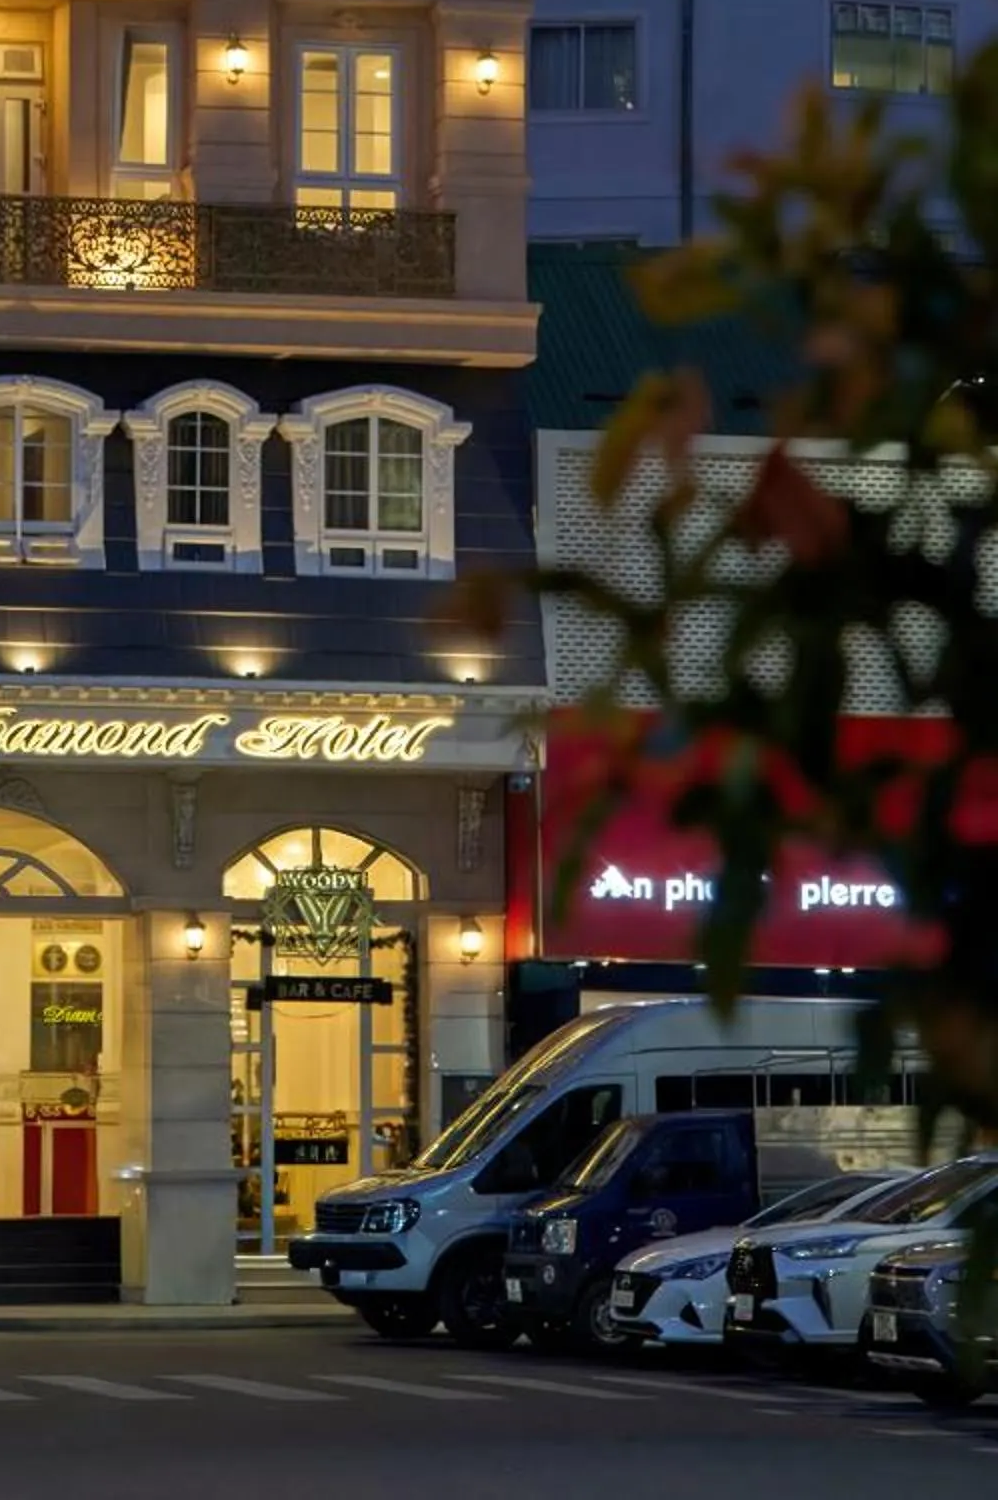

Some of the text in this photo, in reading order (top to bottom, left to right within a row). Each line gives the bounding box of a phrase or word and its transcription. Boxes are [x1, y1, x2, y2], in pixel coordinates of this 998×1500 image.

[235, 713, 454, 762] Hotel
[278, 871, 360, 891] WOODY
[801, 875, 896, 911] pierre
